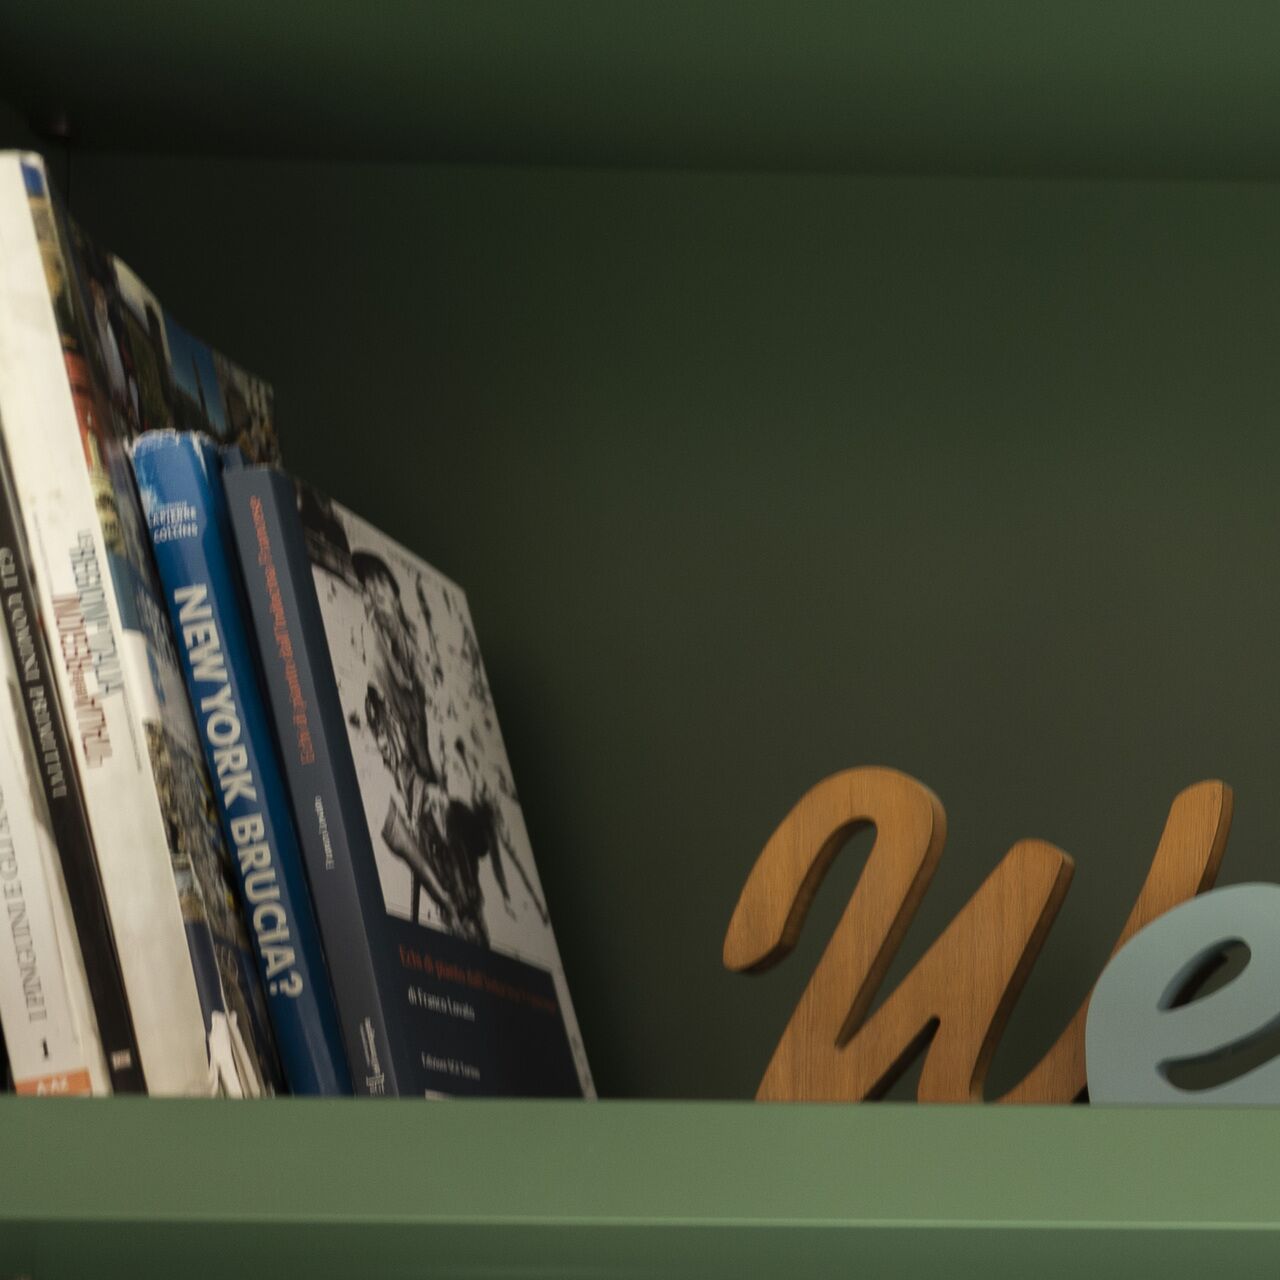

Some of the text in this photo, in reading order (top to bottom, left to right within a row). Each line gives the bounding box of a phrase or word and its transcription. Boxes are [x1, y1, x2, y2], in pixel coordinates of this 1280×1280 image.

[174, 583, 304, 1000] NEW YORK BRUCIA?
